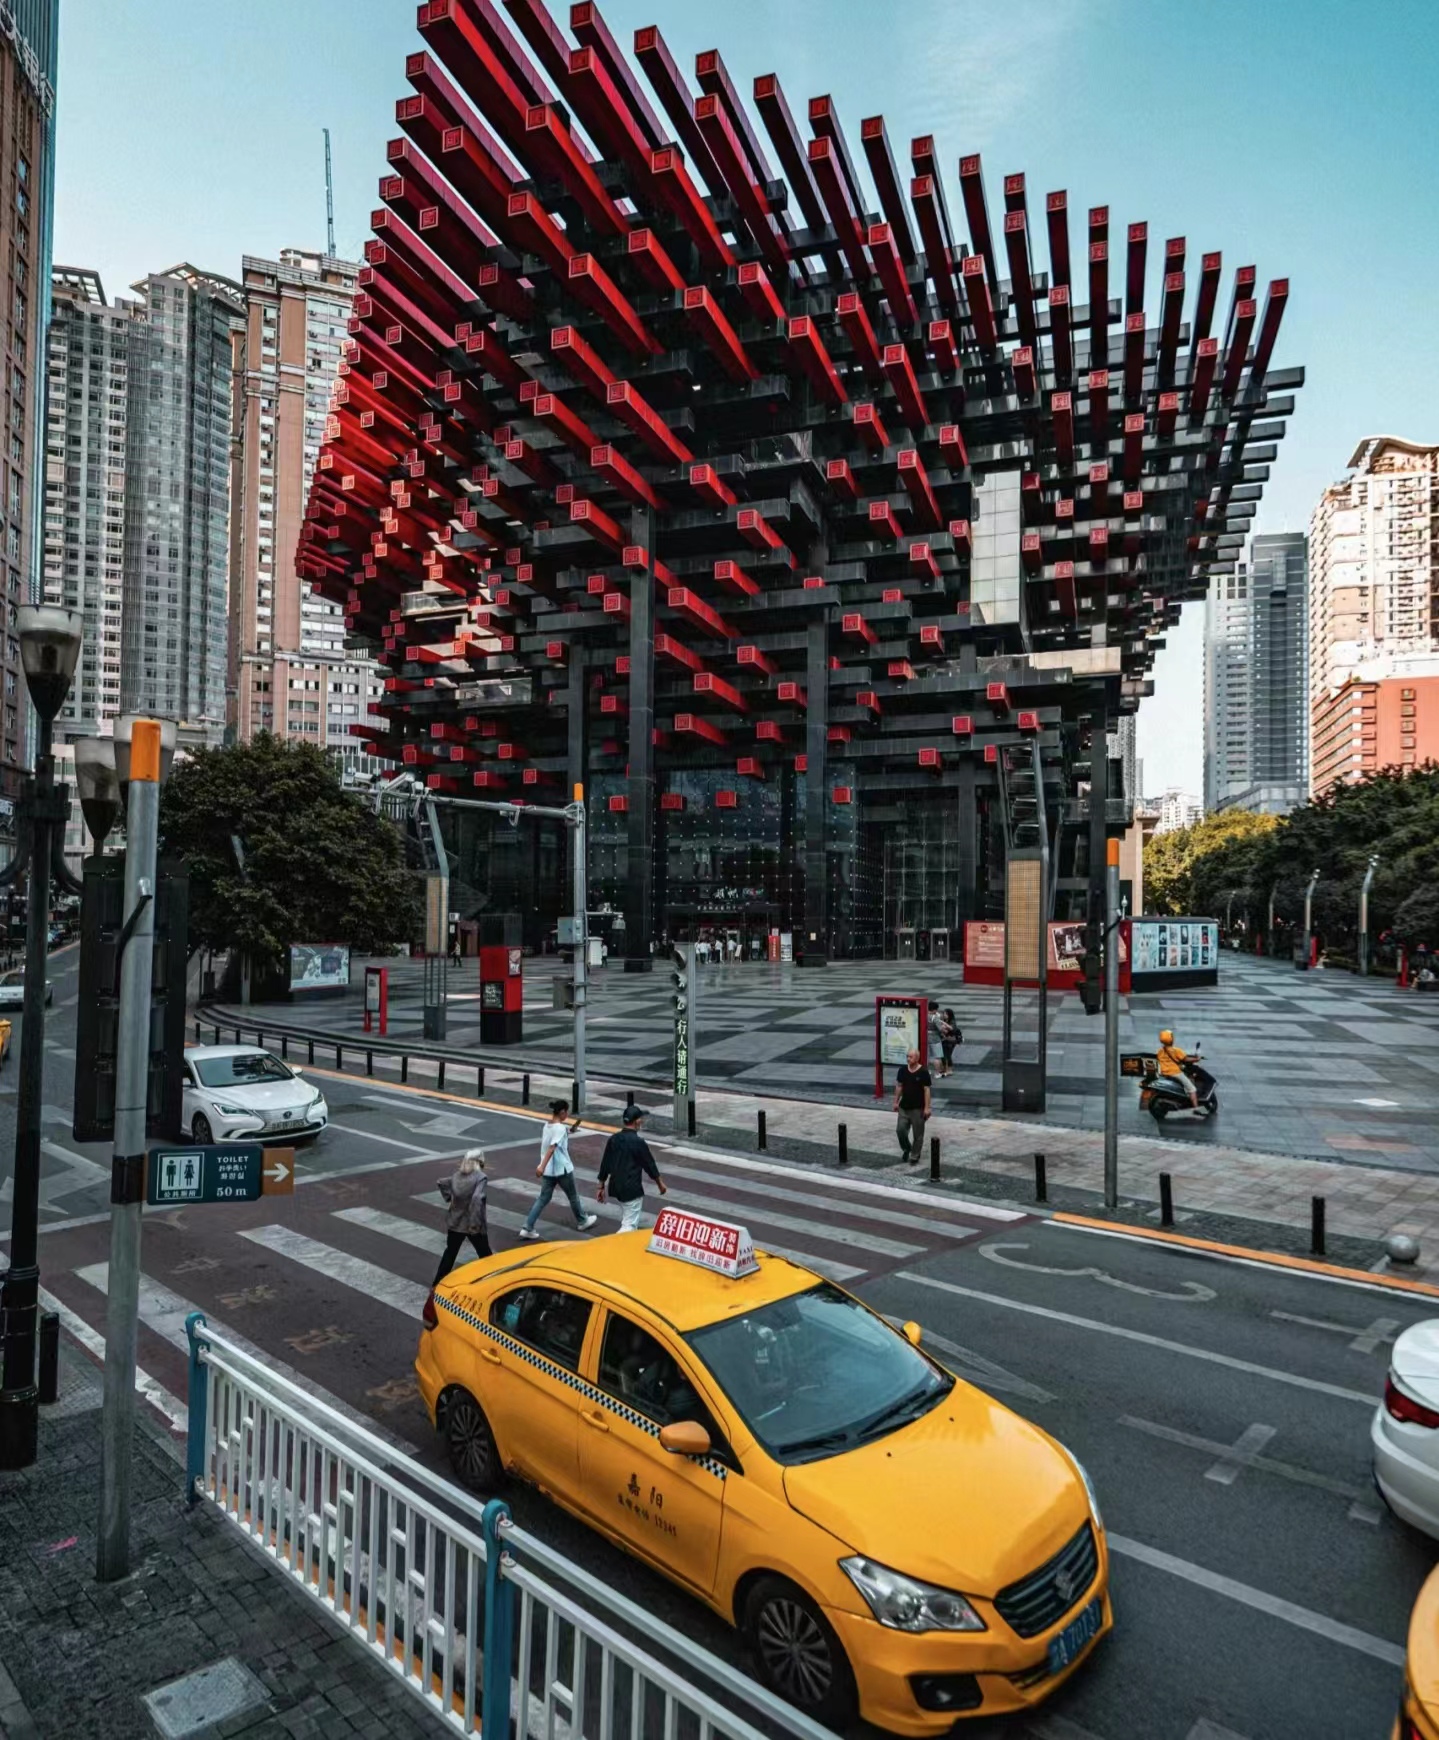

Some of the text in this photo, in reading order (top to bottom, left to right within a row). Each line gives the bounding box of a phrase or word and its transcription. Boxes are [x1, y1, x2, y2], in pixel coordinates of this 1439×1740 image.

[677, 1020, 688, 1095] 行人请通行
[216, 1187, 247, 1197] 50 m
[659, 1213, 729, 1252] 辞旧迎新
